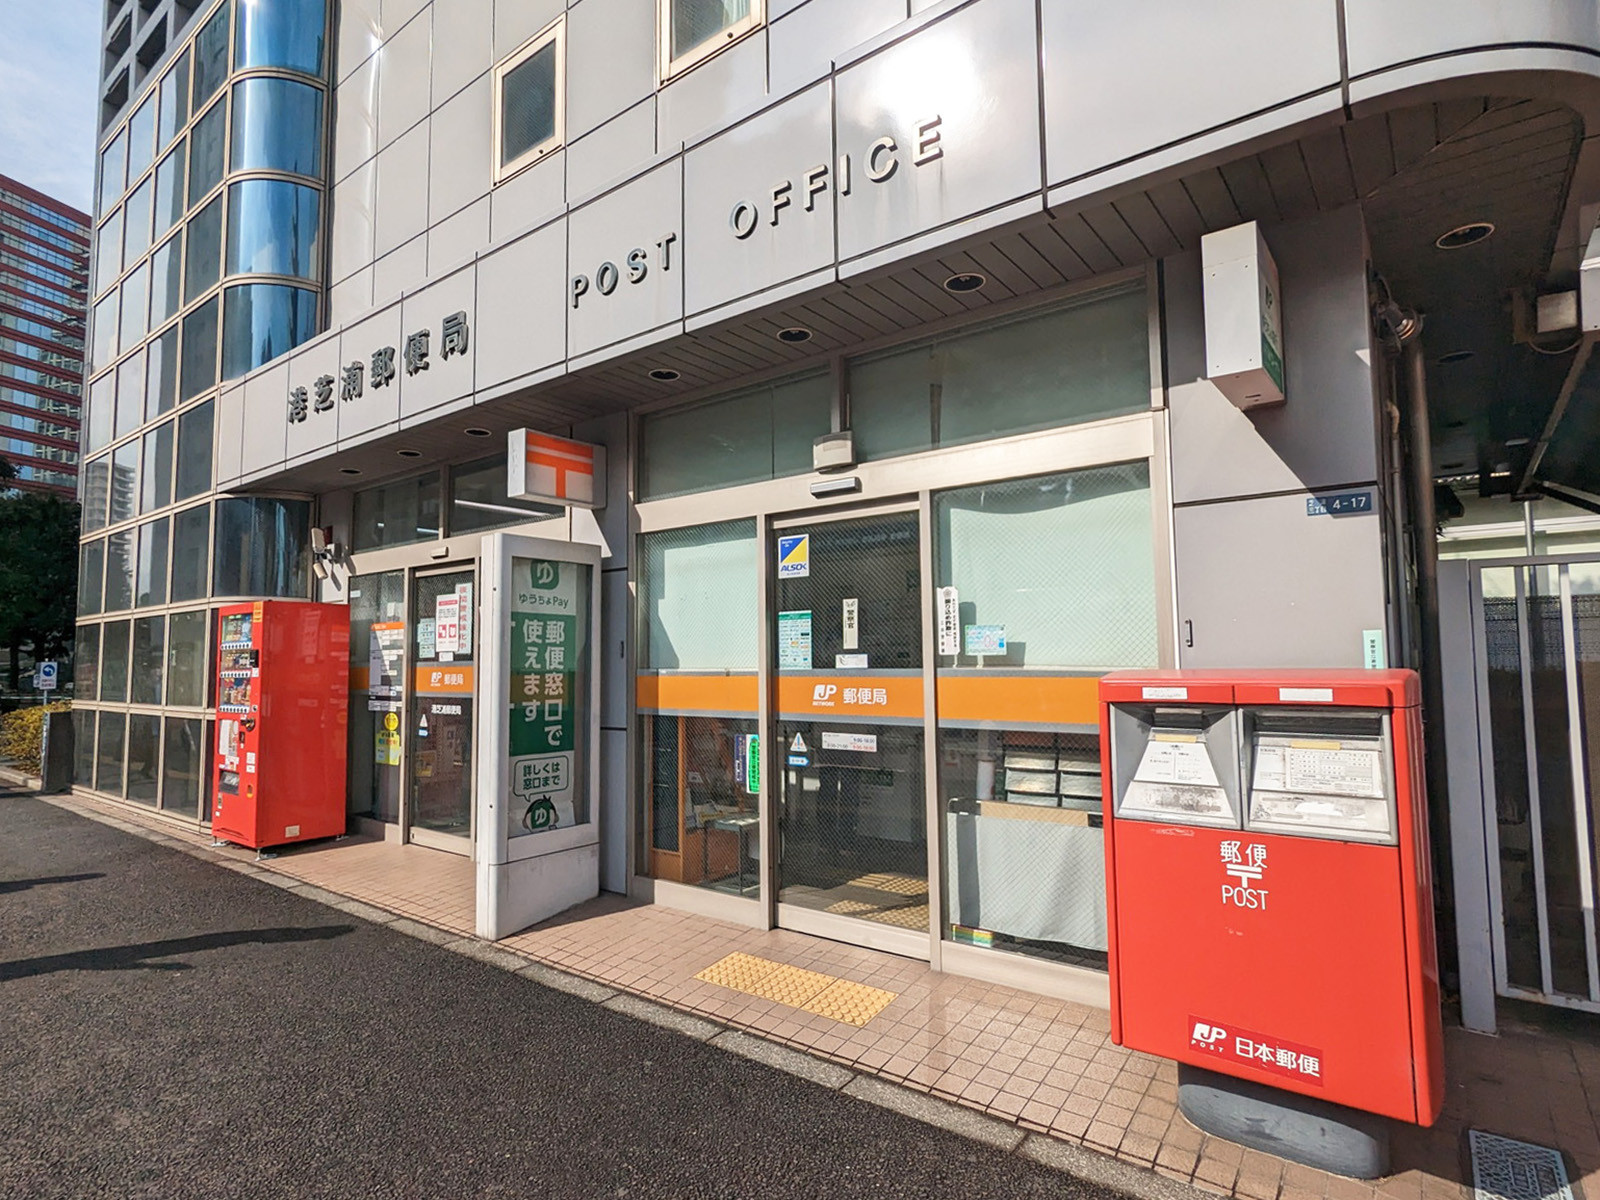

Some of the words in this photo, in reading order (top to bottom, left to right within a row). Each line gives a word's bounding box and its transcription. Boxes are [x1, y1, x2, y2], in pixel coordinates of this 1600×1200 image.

[571, 232, 677, 308] POST
[728, 114, 944, 240] OFFICE
[288, 310, 469, 424] 港芝浦郵便局
[1332, 496, 1367, 510] 4-17
[537, 561, 554, 584] ゆ
[780, 563, 807, 572] ALSOK
[518, 593, 569, 609] ゆうちょPay
[444, 673, 464, 685] 郵便局
[522, 618, 544, 723] 使えます
[544, 620, 565, 747] 郵便窓口で
[843, 687, 887, 705] 郵便局
[522, 761, 561, 778] 詳しくは
[522, 775, 561, 791] 窓口まで
[534, 806, 548, 827] ゆ
[1219, 840, 1268, 869] 郵便
[1221, 884, 1269, 910] POST
[1191, 1039, 1224, 1053] POST
[1235, 1036, 1320, 1078] 日本郵便
